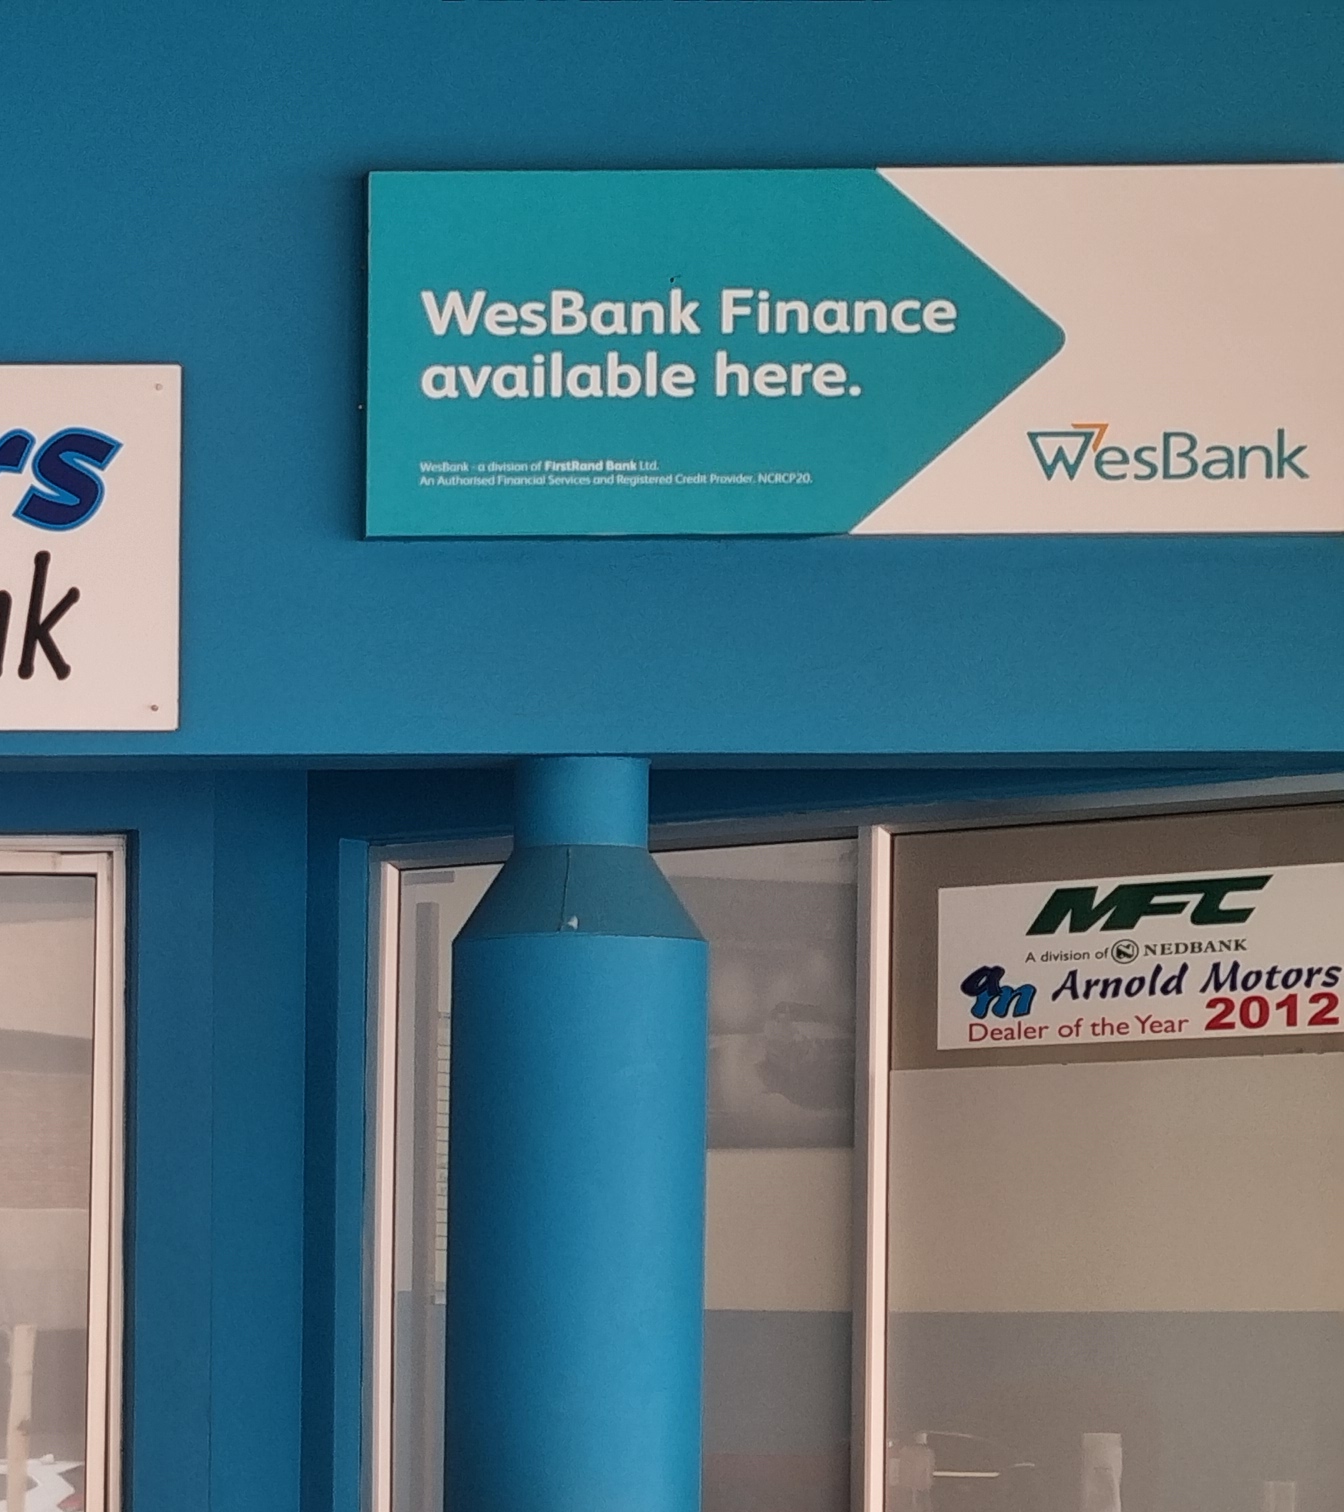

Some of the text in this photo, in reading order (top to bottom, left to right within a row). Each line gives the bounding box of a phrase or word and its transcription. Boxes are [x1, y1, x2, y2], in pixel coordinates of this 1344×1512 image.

[421, 287, 956, 336] WesBank Finance
[421, 351, 861, 399] available here.
[420, 462, 468, 472] WesBank
[488, 462, 528, 472] division
[530, 461, 542, 471] of
[545, 460, 603, 471] FirstRand
[606, 460, 636, 471] Bank
[1027, 424, 1310, 481] WesBank
[420, 476, 434, 485] An
[437, 475, 495, 485] Authorised
[497, 475, 546, 485] Financial
[548, 475, 591, 485] Services
[593, 474, 614, 484] and
[616, 474, 673, 487] Registered
[675, 473, 707, 484] Credit
[1025, 874, 1274, 936] MFC
[1025, 939, 1246, 963] A division of NEDBANK
[1052, 962, 1189, 1002] Arnold
[1200, 960, 1343, 994] Motors
[968, 991, 1341, 1043] Dealer of the Year 2012
